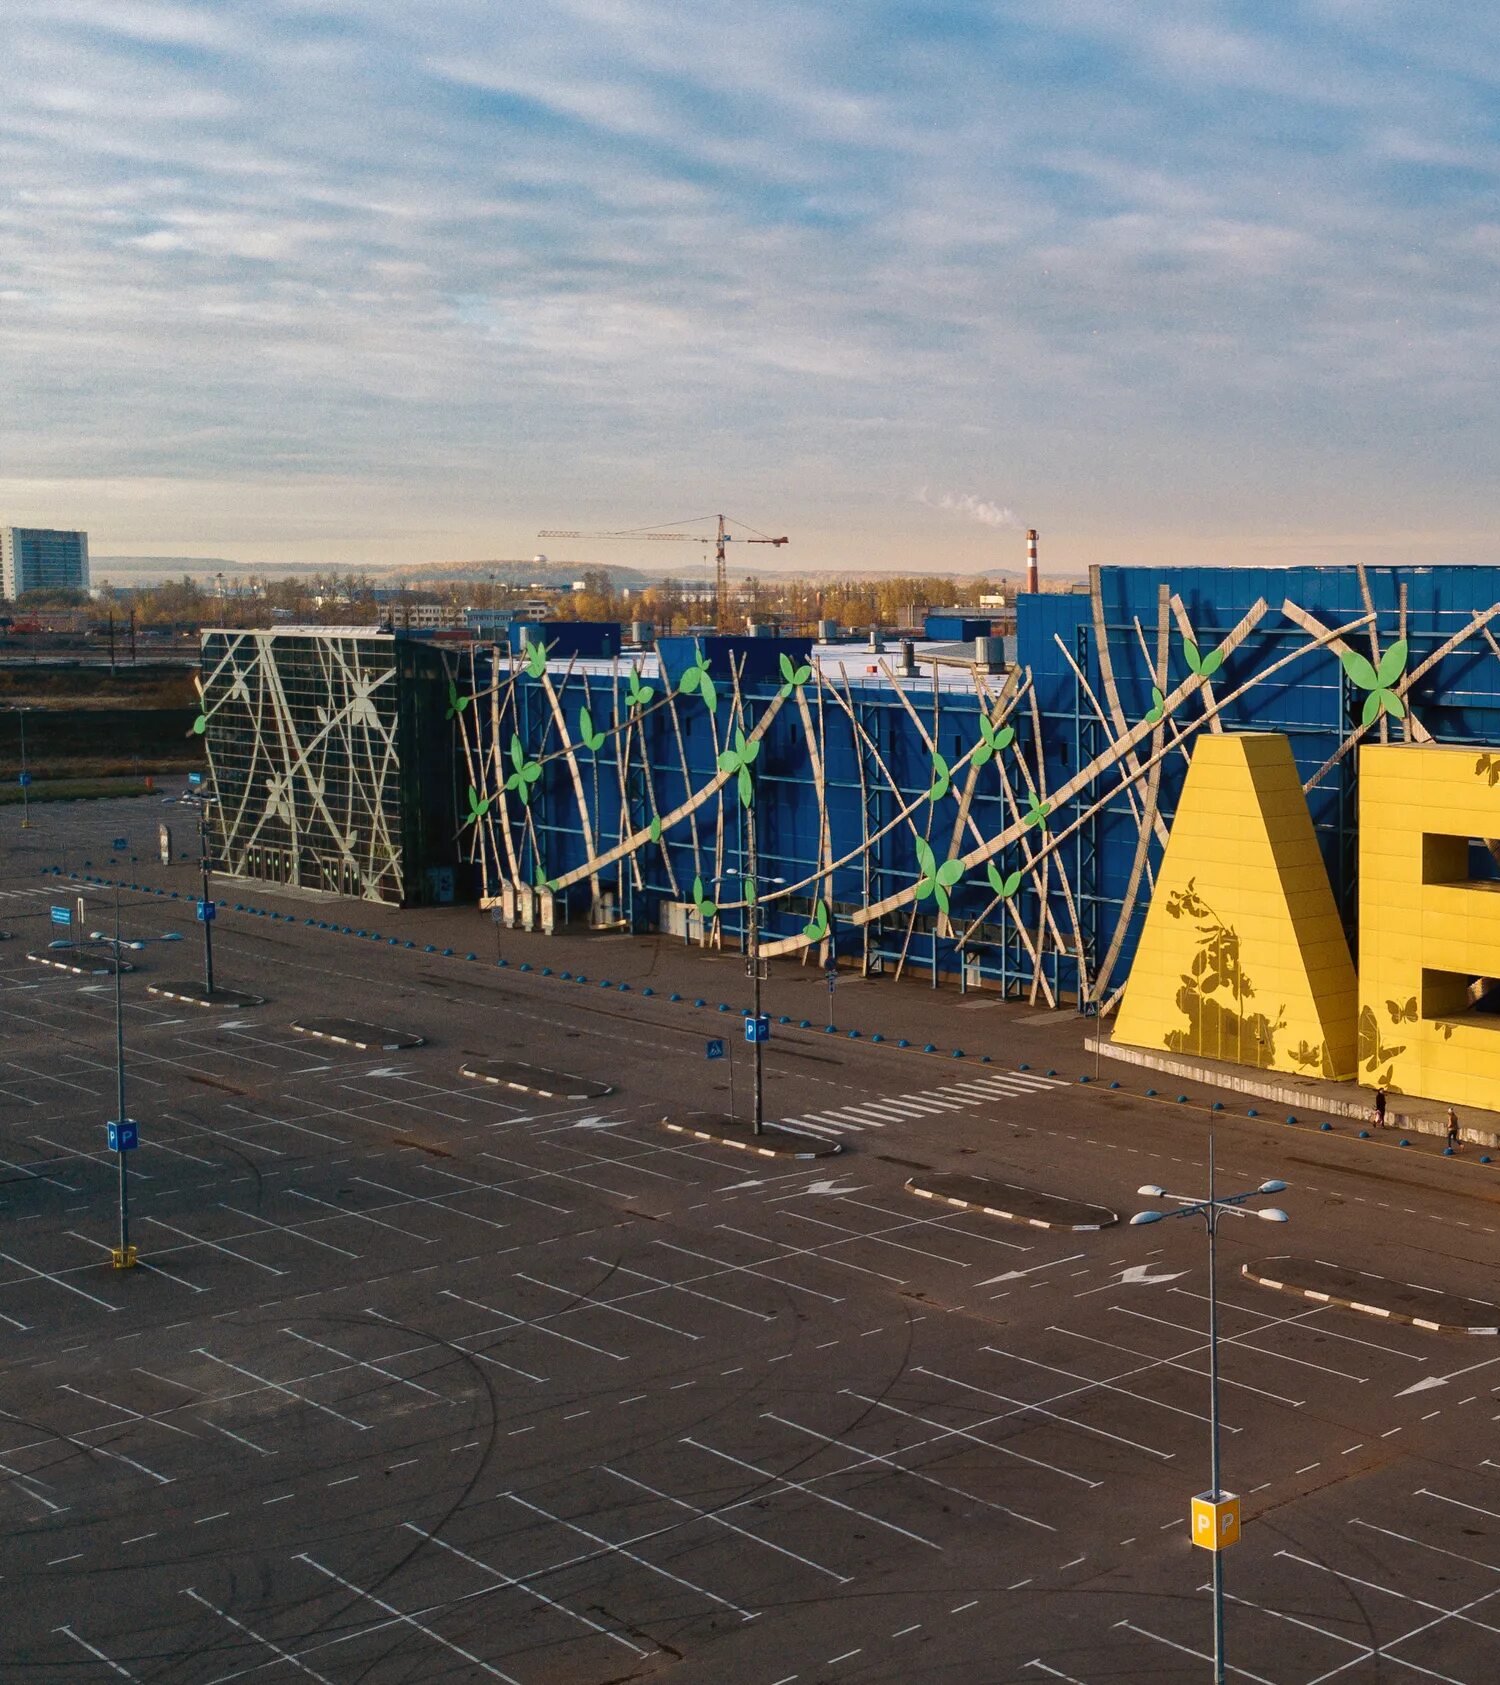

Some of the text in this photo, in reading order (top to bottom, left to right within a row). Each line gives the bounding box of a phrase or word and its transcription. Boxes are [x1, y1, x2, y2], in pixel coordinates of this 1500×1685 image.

[748, 1025, 753, 1034] P
[759, 1025, 765, 1034] P
[110, 1131, 115, 1142] P
[123, 1131, 132, 1143] P
[1198, 1513, 1210, 1534] P
[1222, 1513, 1234, 1535] P
